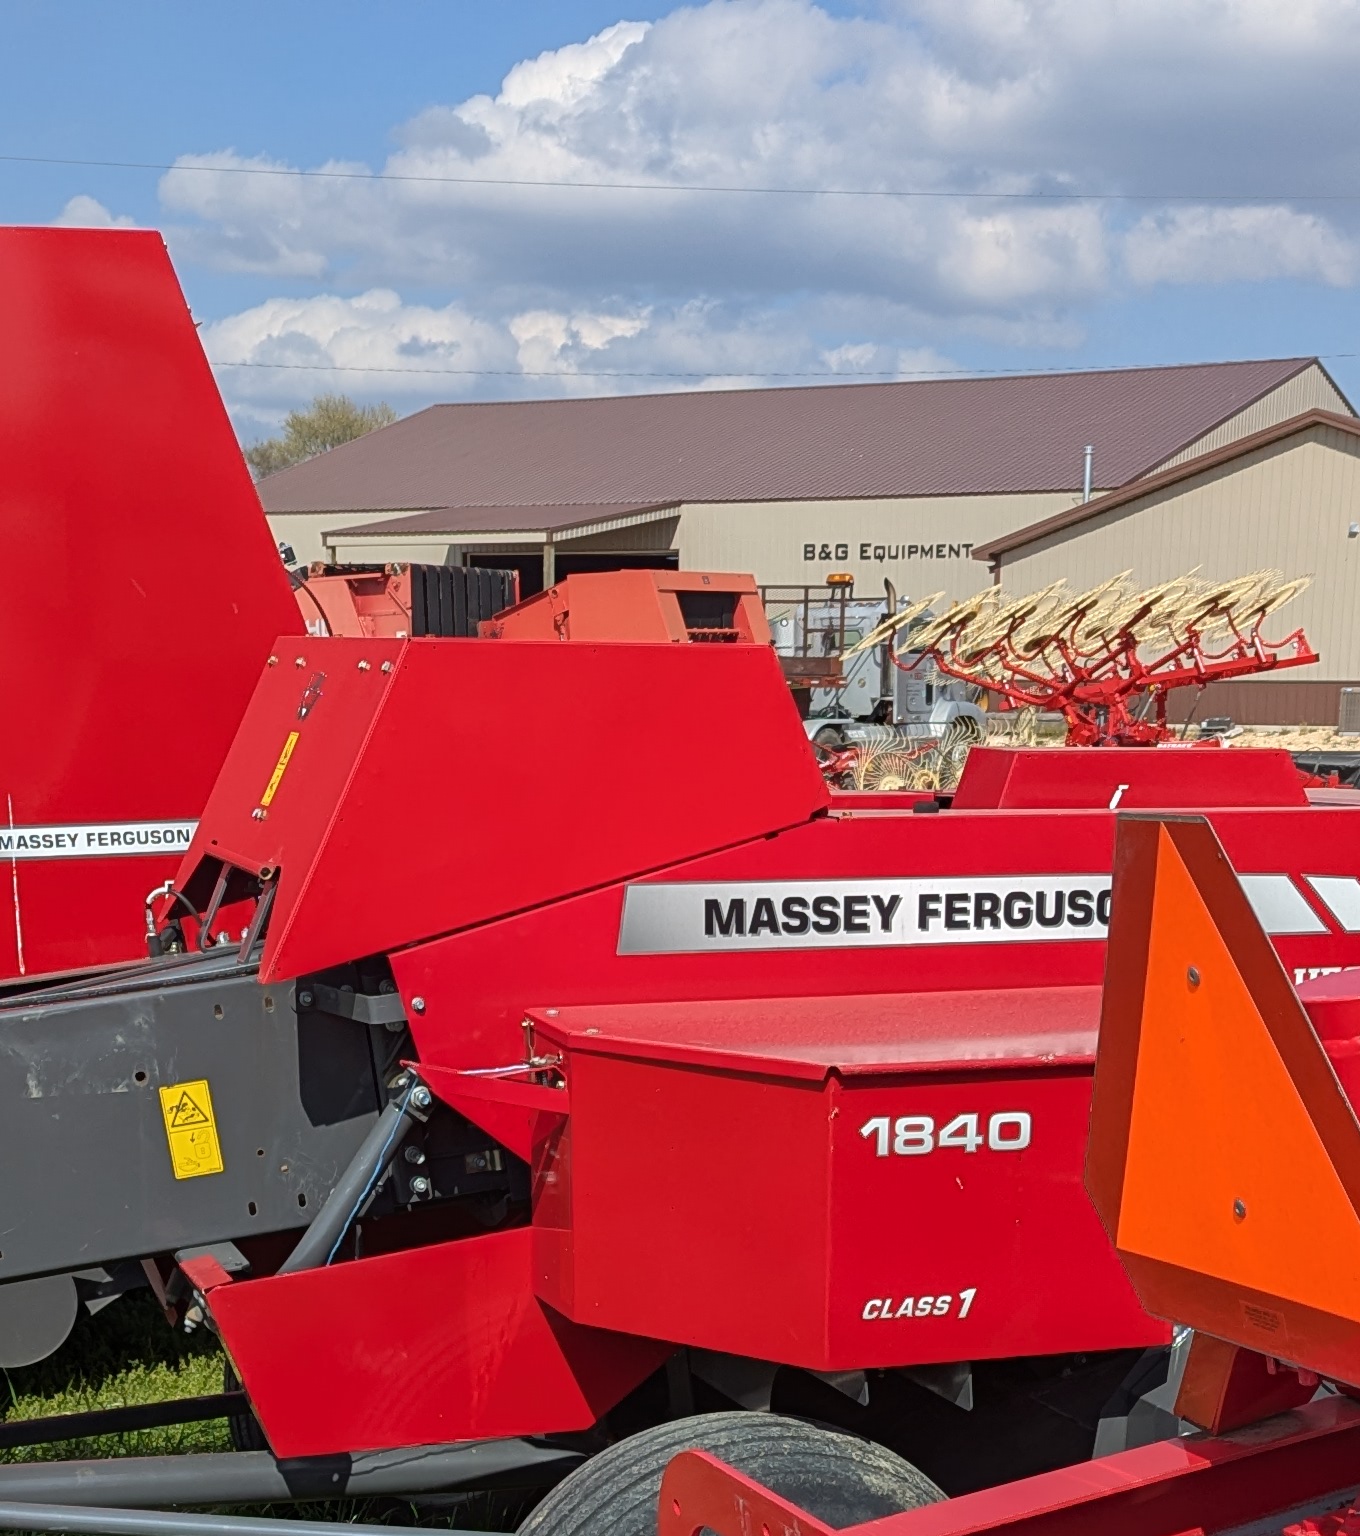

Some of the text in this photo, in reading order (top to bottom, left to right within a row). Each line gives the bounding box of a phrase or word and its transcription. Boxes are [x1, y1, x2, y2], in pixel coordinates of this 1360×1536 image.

[803, 543, 849, 561] B&G
[86, 828, 191, 848] FERGUSON
[704, 889, 1112, 938] MASSEY FERGUSO
[860, 1112, 1031, 1157] 1840
[861, 1287, 978, 1320] CLASS 1
